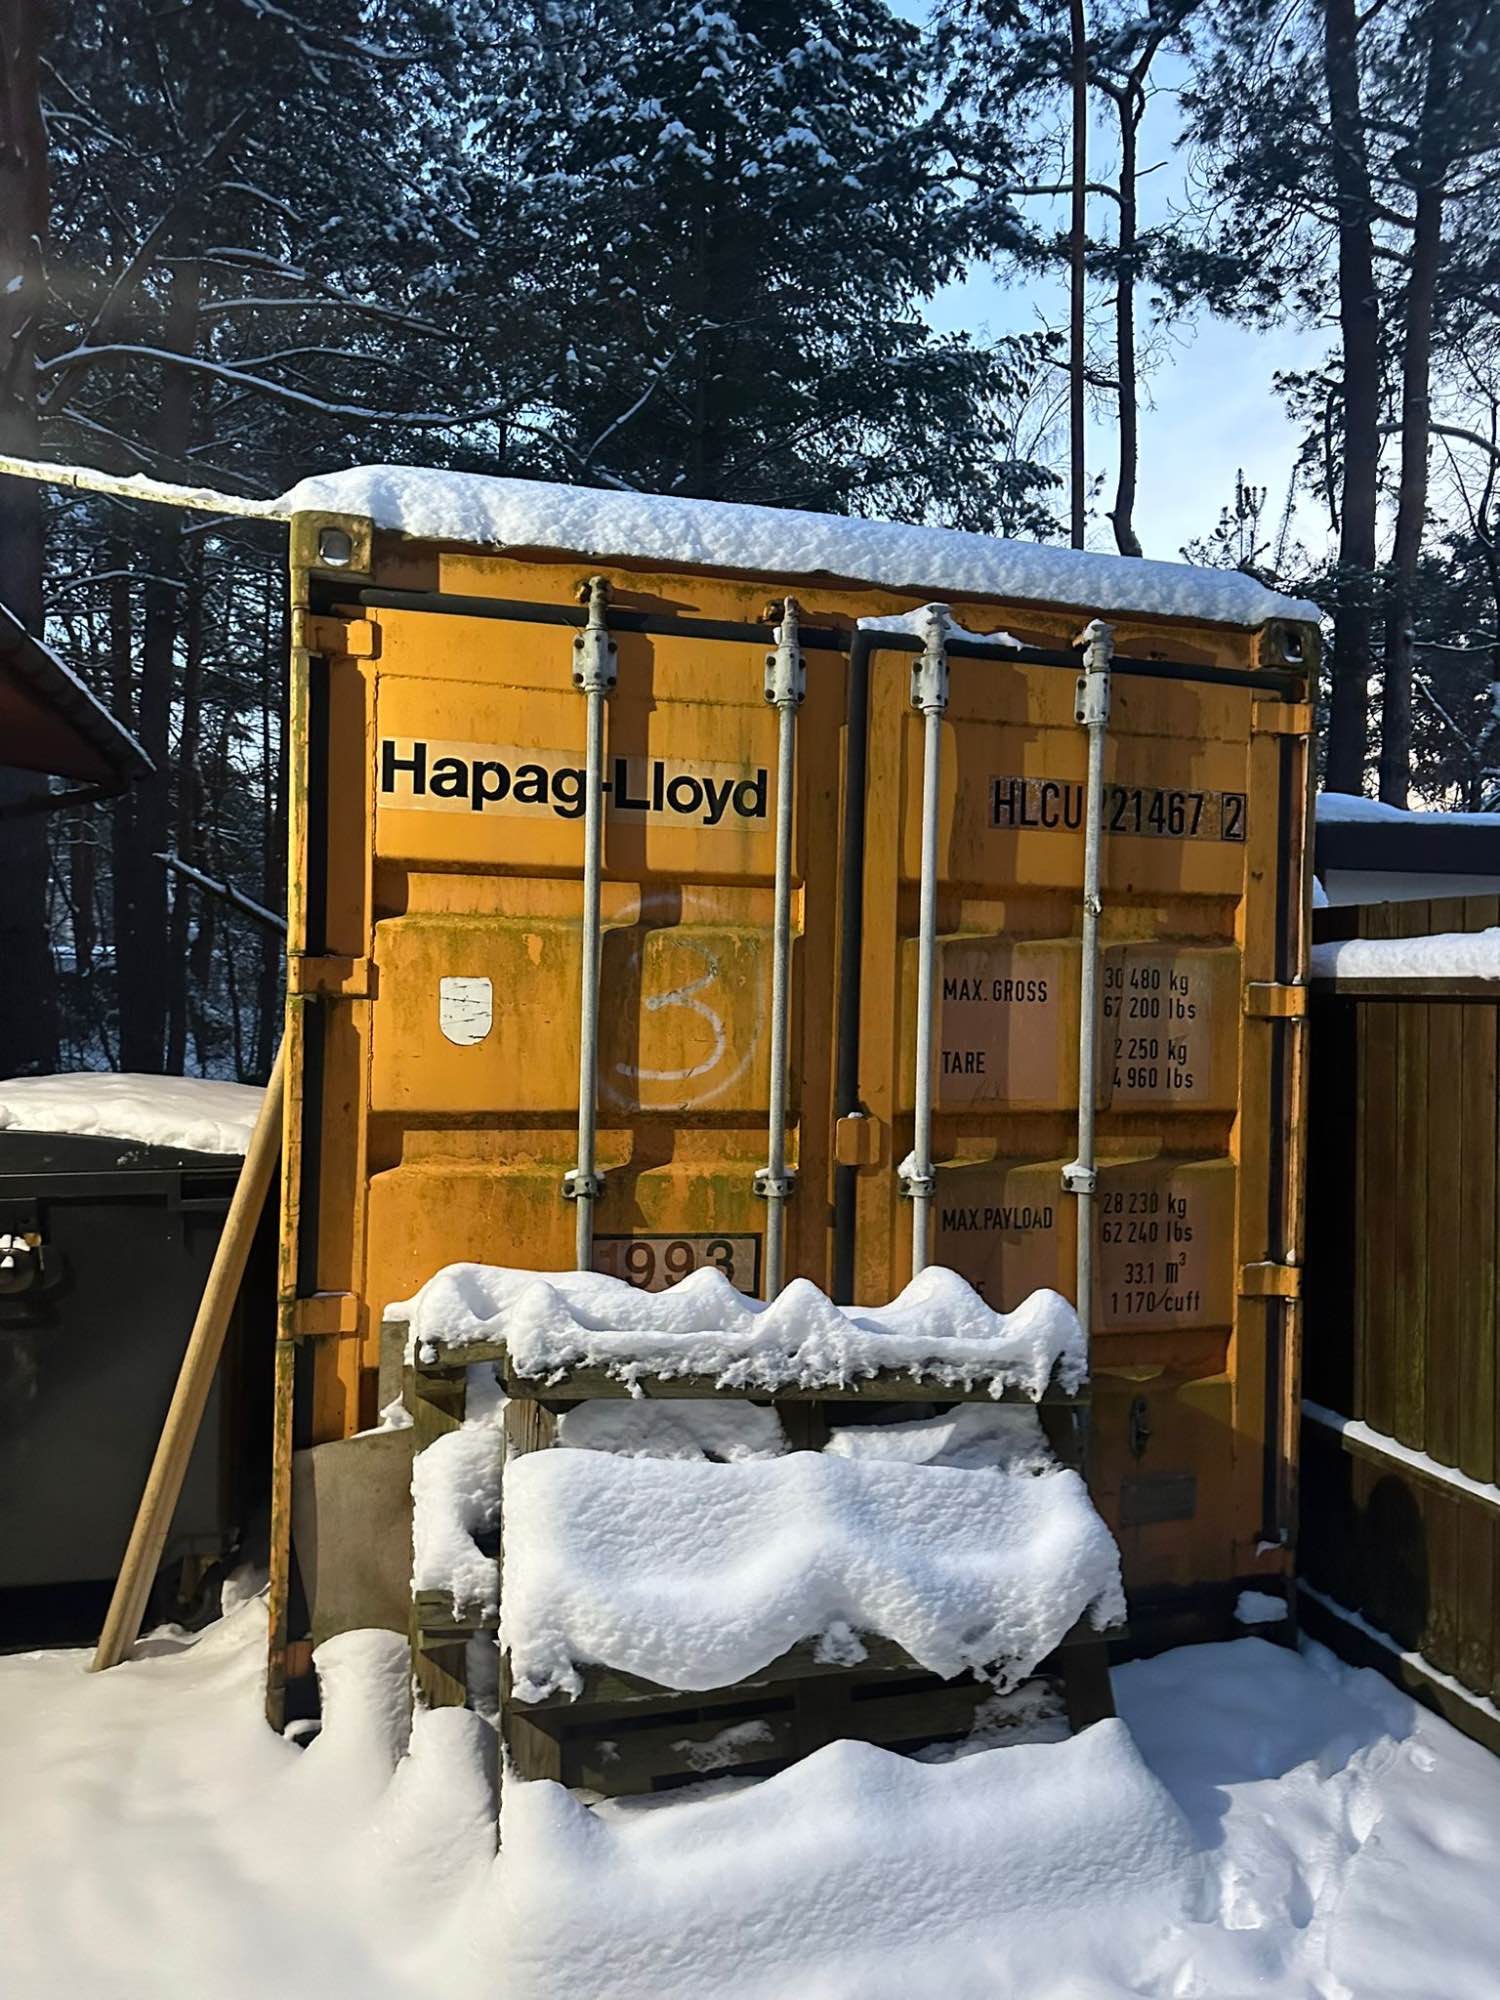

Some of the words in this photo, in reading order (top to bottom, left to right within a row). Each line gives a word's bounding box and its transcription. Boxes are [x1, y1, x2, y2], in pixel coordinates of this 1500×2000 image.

[381, 740, 769, 826] Hapag-Lloyd
[993, 779, 1083, 829] HLCU
[1224, 795, 1245, 838] 2
[943, 977, 988, 1001] MAX.
[992, 978, 1048, 1002] GROSS
[1104, 967, 1124, 989] 30
[1129, 968, 1161, 990] 480
[1168, 969, 1189, 996] kg
[1103, 996, 1122, 1018] 67
[1128, 997, 1160, 1019] 200
[1168, 998, 1197, 1020] lbs
[942, 1051, 985, 1074] TARE
[1128, 1037, 1159, 1060] 250
[1167, 1040, 1188, 1066] kg
[1127, 1066, 1158, 1088] 960
[1166, 1067, 1194, 1088] lbs
[1103, 1193, 1123, 1214] 28
[1128, 1193, 1159, 1214] 230
[1167, 1193, 1187, 1219] kg
[1102, 1222, 1122, 1244] 62
[1127, 1221, 1159, 1243] 240
[1166, 1221, 1193, 1243] lbs
[1124, 1262, 1155, 1285] 33.1
